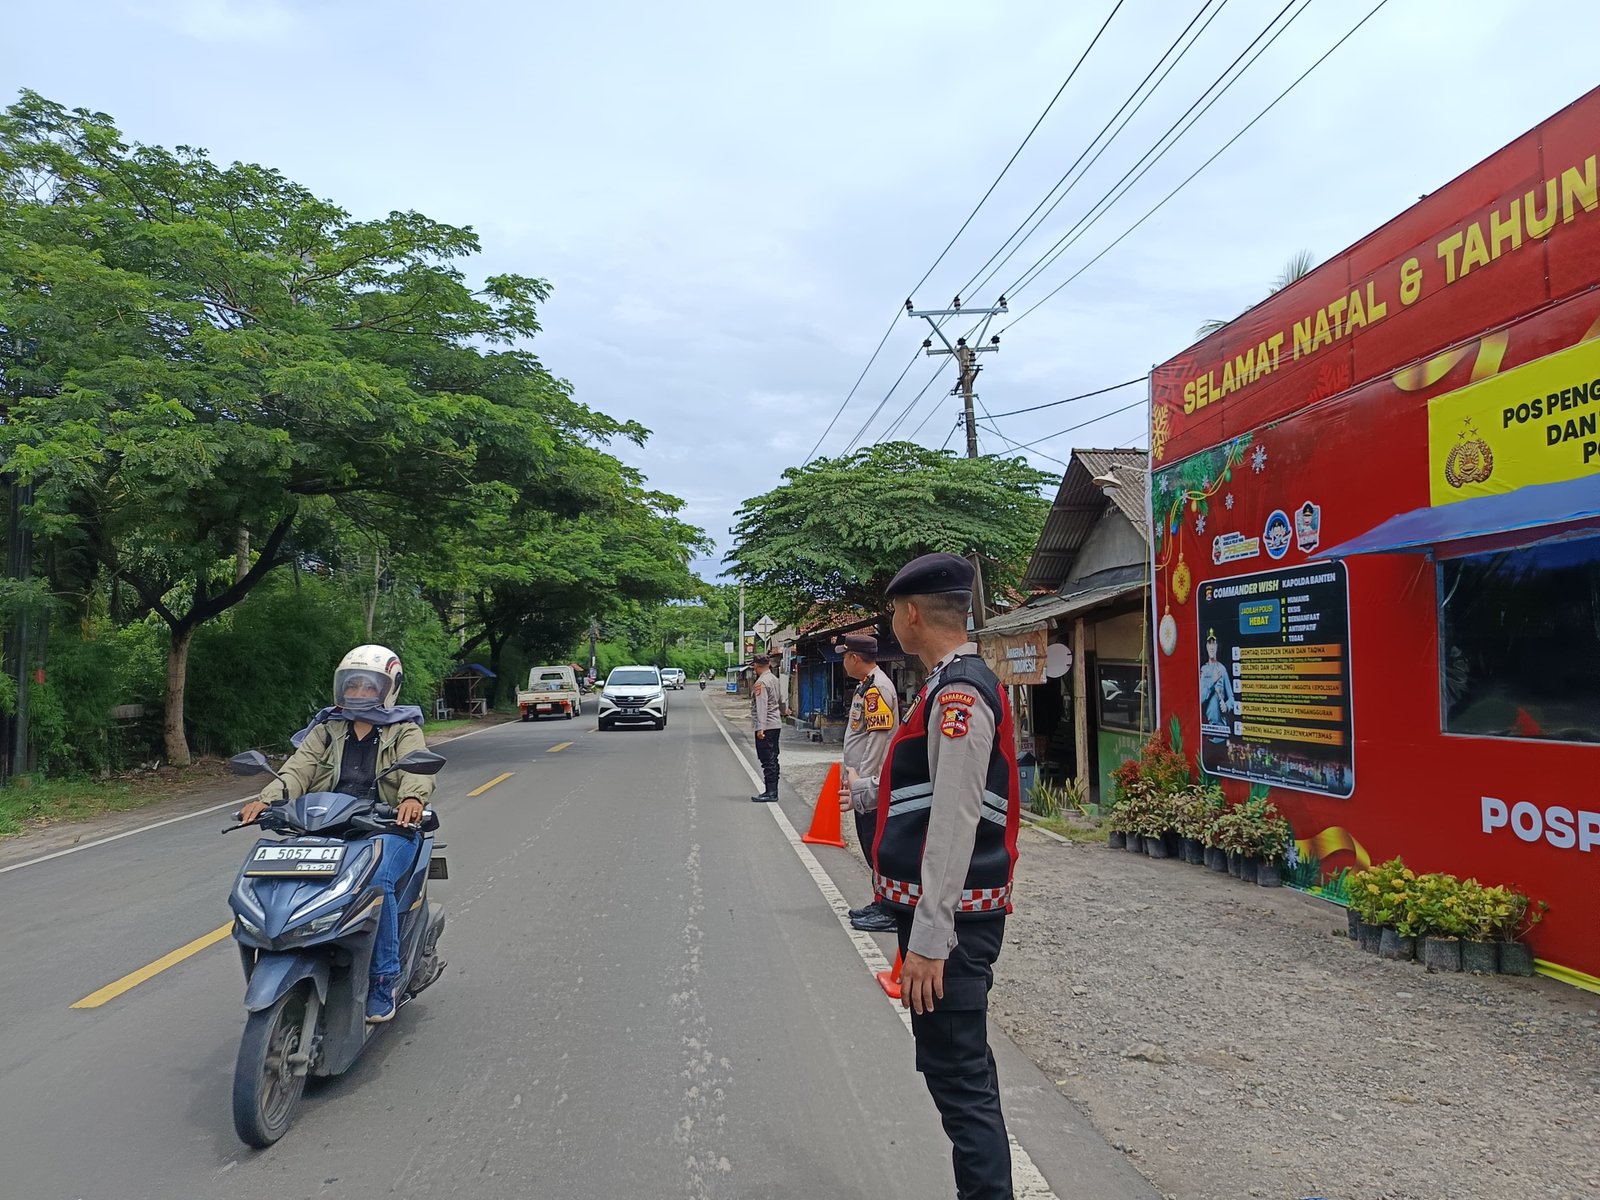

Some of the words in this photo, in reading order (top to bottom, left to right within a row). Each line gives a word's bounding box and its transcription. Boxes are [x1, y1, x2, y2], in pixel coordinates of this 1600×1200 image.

[1183, 331, 1285, 415] SELAMAT
[1292, 282, 1388, 362] NATAL
[1400, 256, 1423, 306] &
[1437, 154, 1600, 284] TAHUN
[1502, 398, 1543, 428] POS
[1546, 412, 1596, 446] DAN
[1583, 441, 1600, 464] P
[1214, 583, 1258, 598] COMMANDER
[1258, 580, 1279, 592] WISH
[1282, 576, 1309, 588] KAPOLDA
[1310, 572, 1336, 584] BANTEN
[1249, 616, 1268, 626] HEBAT
[941, 694, 972, 704] BAHARKAM
[1481, 796, 1600, 852] POSP
[257, 849, 267, 859] A
[277, 849, 312, 859] 5057
[321, 849, 337, 859] CI
